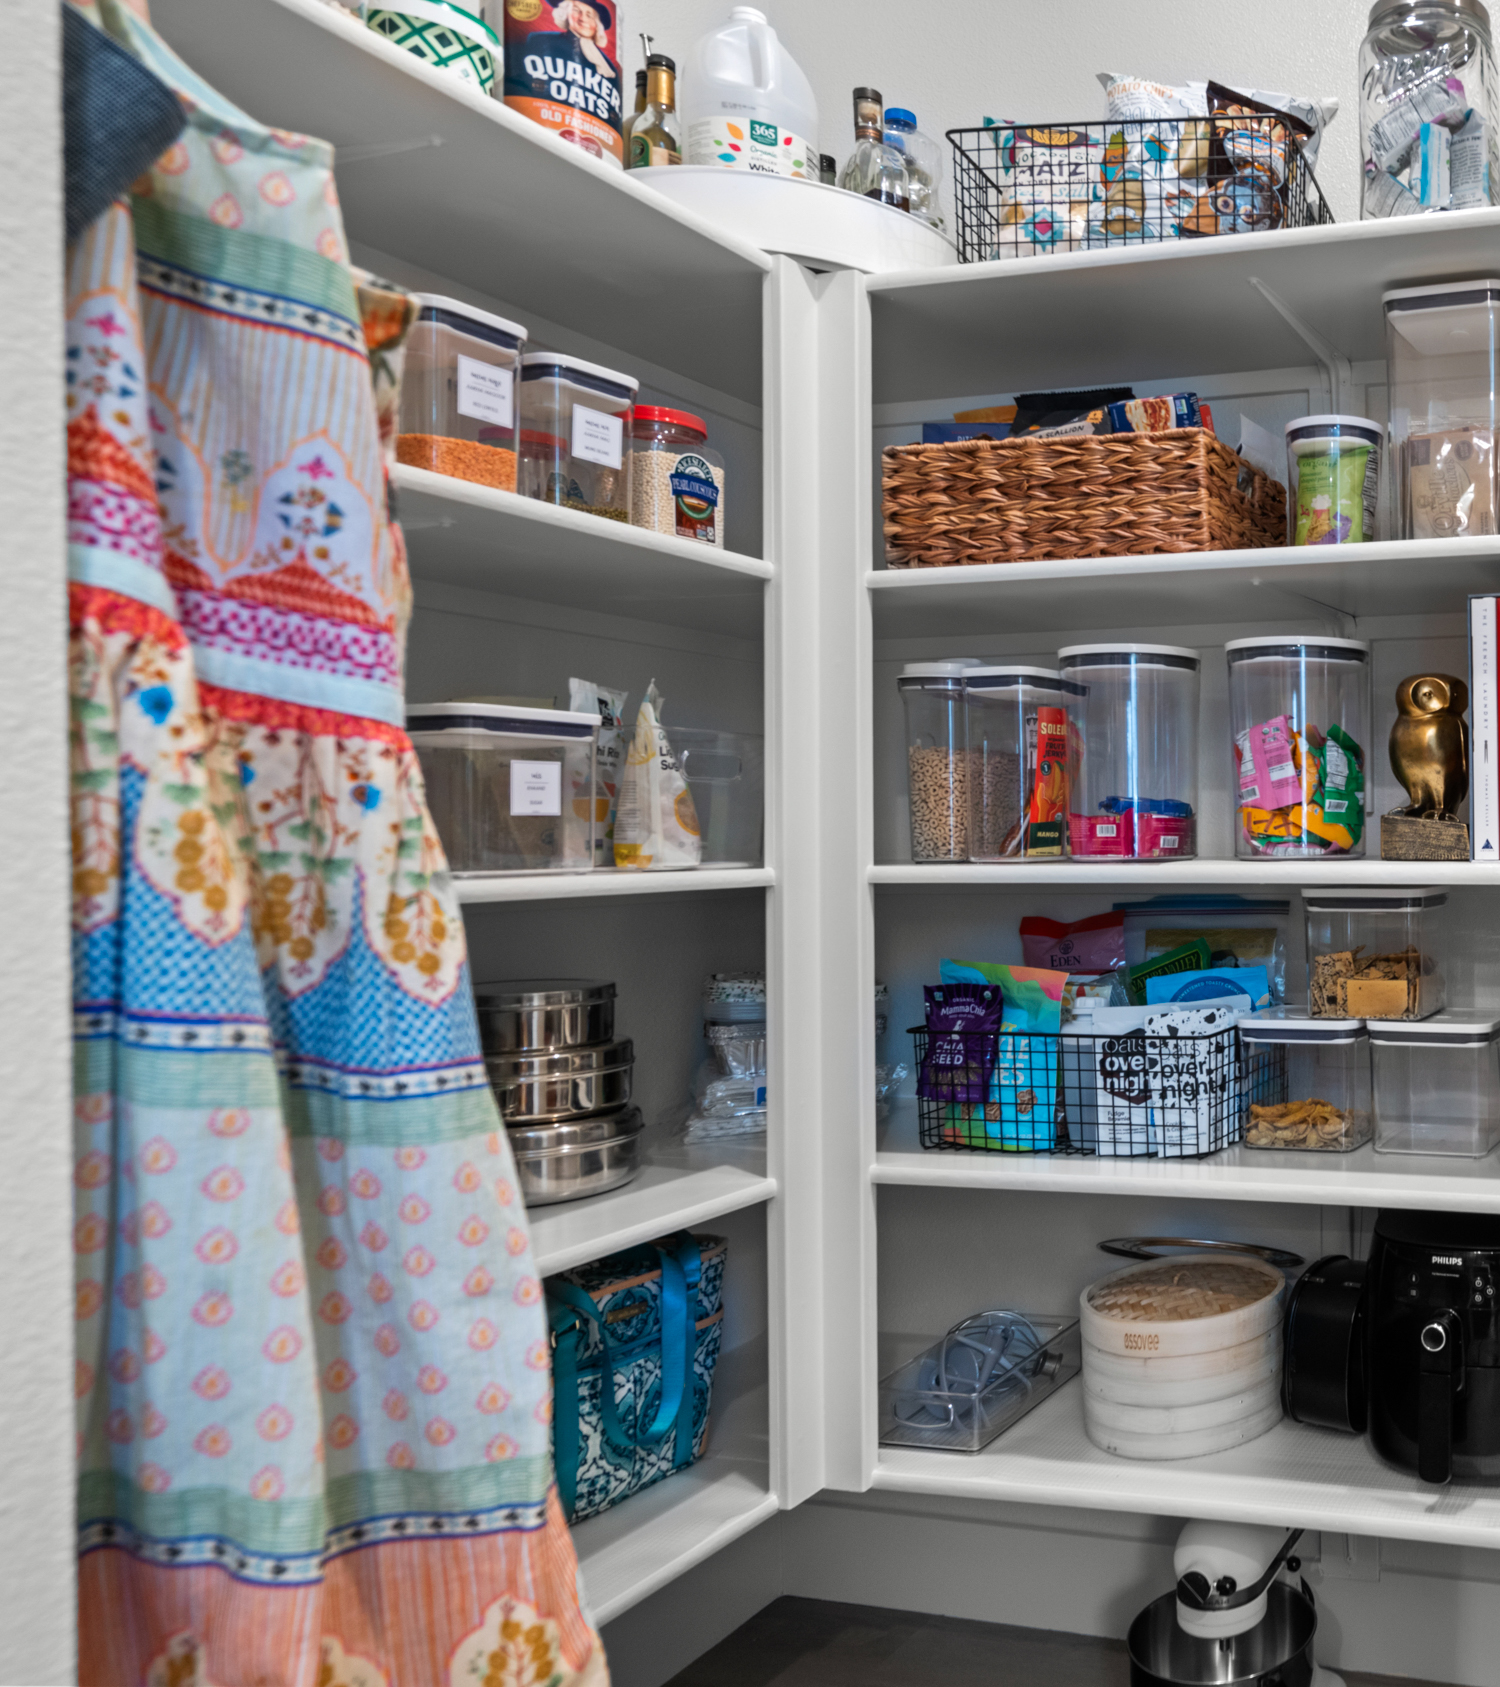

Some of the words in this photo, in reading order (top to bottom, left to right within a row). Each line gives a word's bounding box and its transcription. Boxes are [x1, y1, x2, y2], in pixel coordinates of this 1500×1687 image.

[523, 54, 622, 115] QUAKER
[1107, 82, 1141, 100] POTATO
[1143, 83, 1174, 99] CHIPS
[550, 80, 609, 120] OATS
[540, 108, 562, 123] OLD
[565, 114, 614, 146] FASHIONED
[752, 124, 776, 140] 365
[1045, 425, 1085, 438] SCALLION
[1050, 955, 1081, 967] EDEN
[1164, 953, 1198, 976] VALLEY
[935, 1041, 965, 1054] CHIA
[932, 1054, 963, 1065] SEED
[1161, 1060, 1207, 1078] over
[1431, 1255, 1463, 1266] PHILIPS
[1124, 1333, 1160, 1351] essovee
